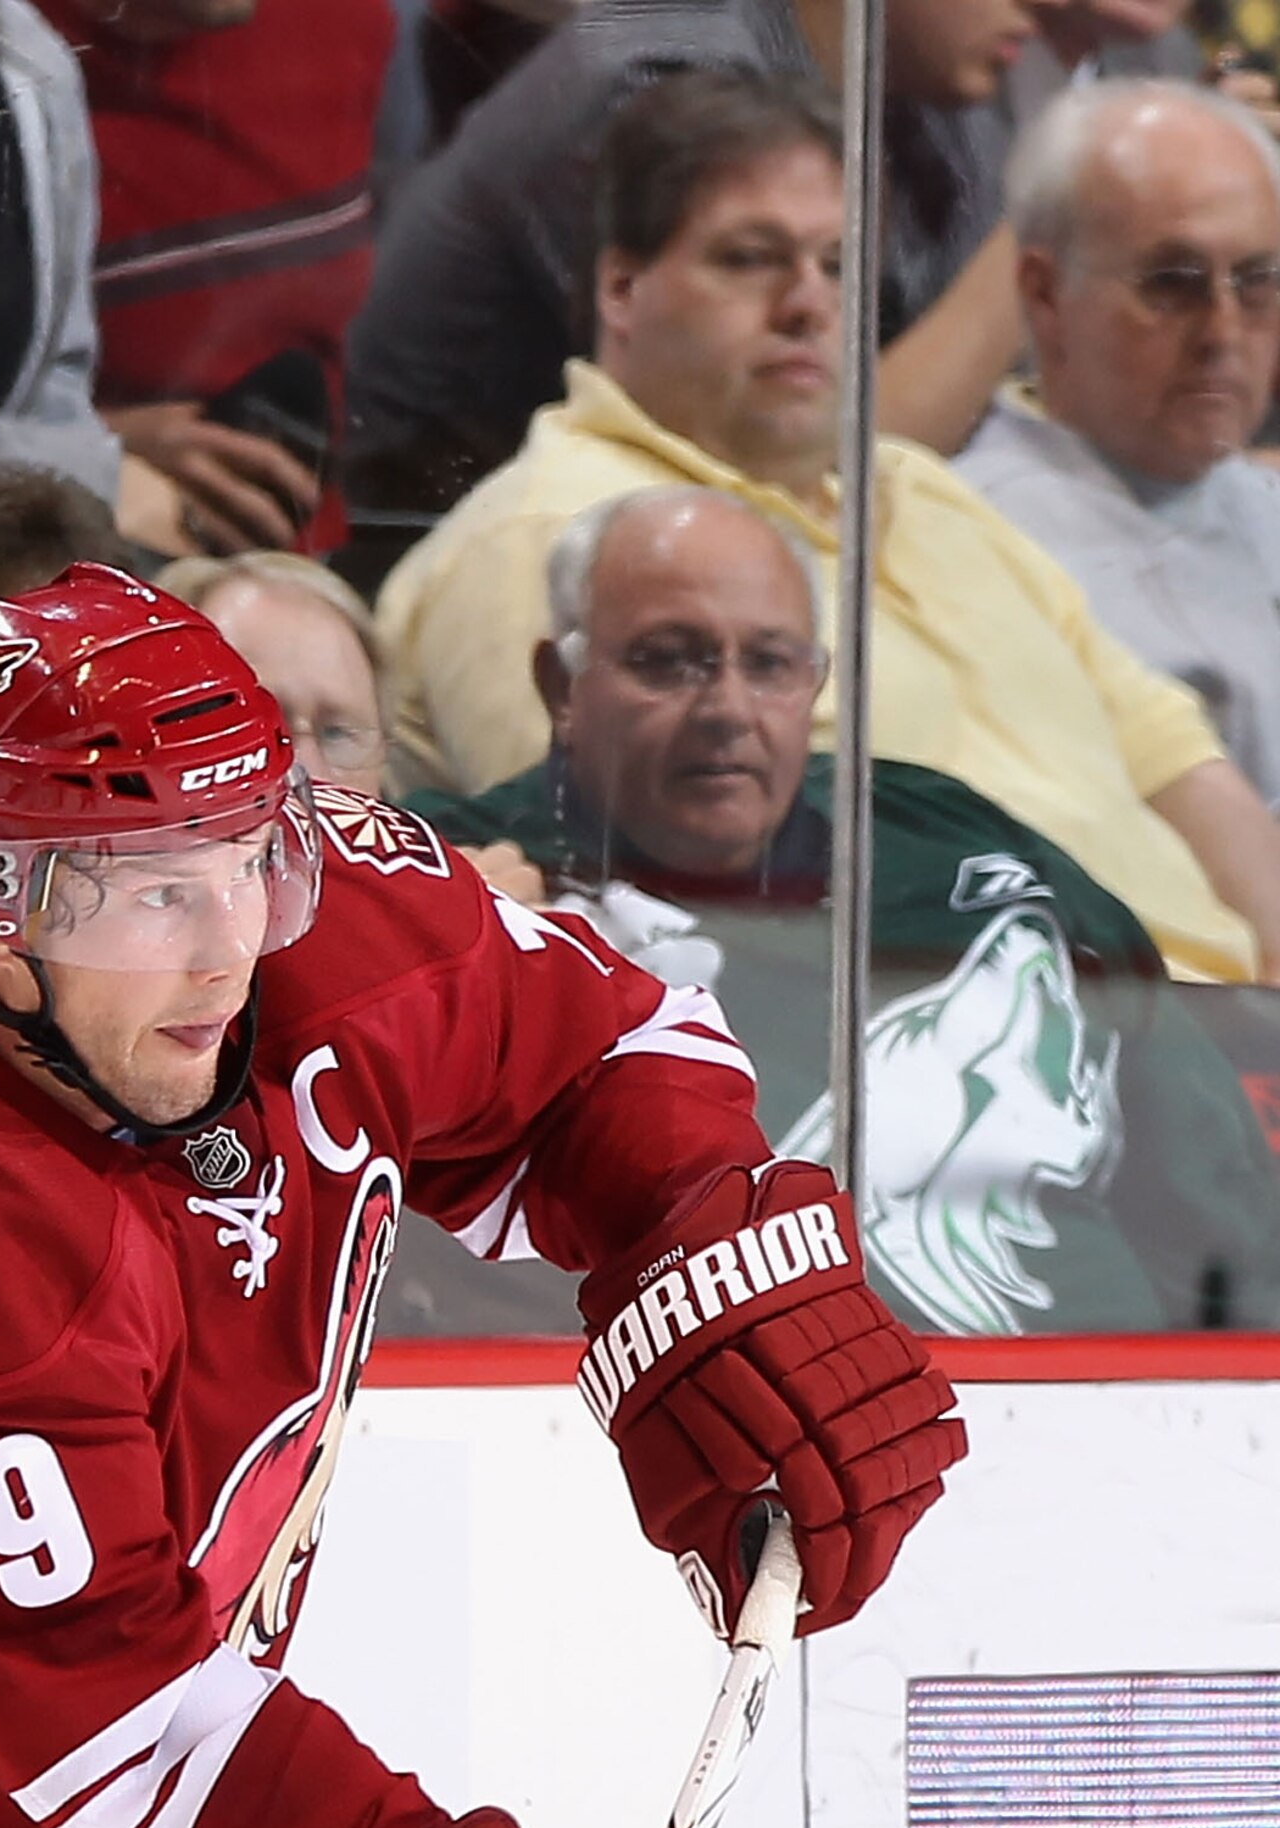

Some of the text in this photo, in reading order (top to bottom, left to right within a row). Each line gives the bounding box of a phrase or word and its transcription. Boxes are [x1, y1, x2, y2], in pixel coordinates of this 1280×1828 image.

[180, 747, 267, 791] CCM
[291, 1044, 371, 1174] C
[577, 1203, 850, 1433] WARRIOR
